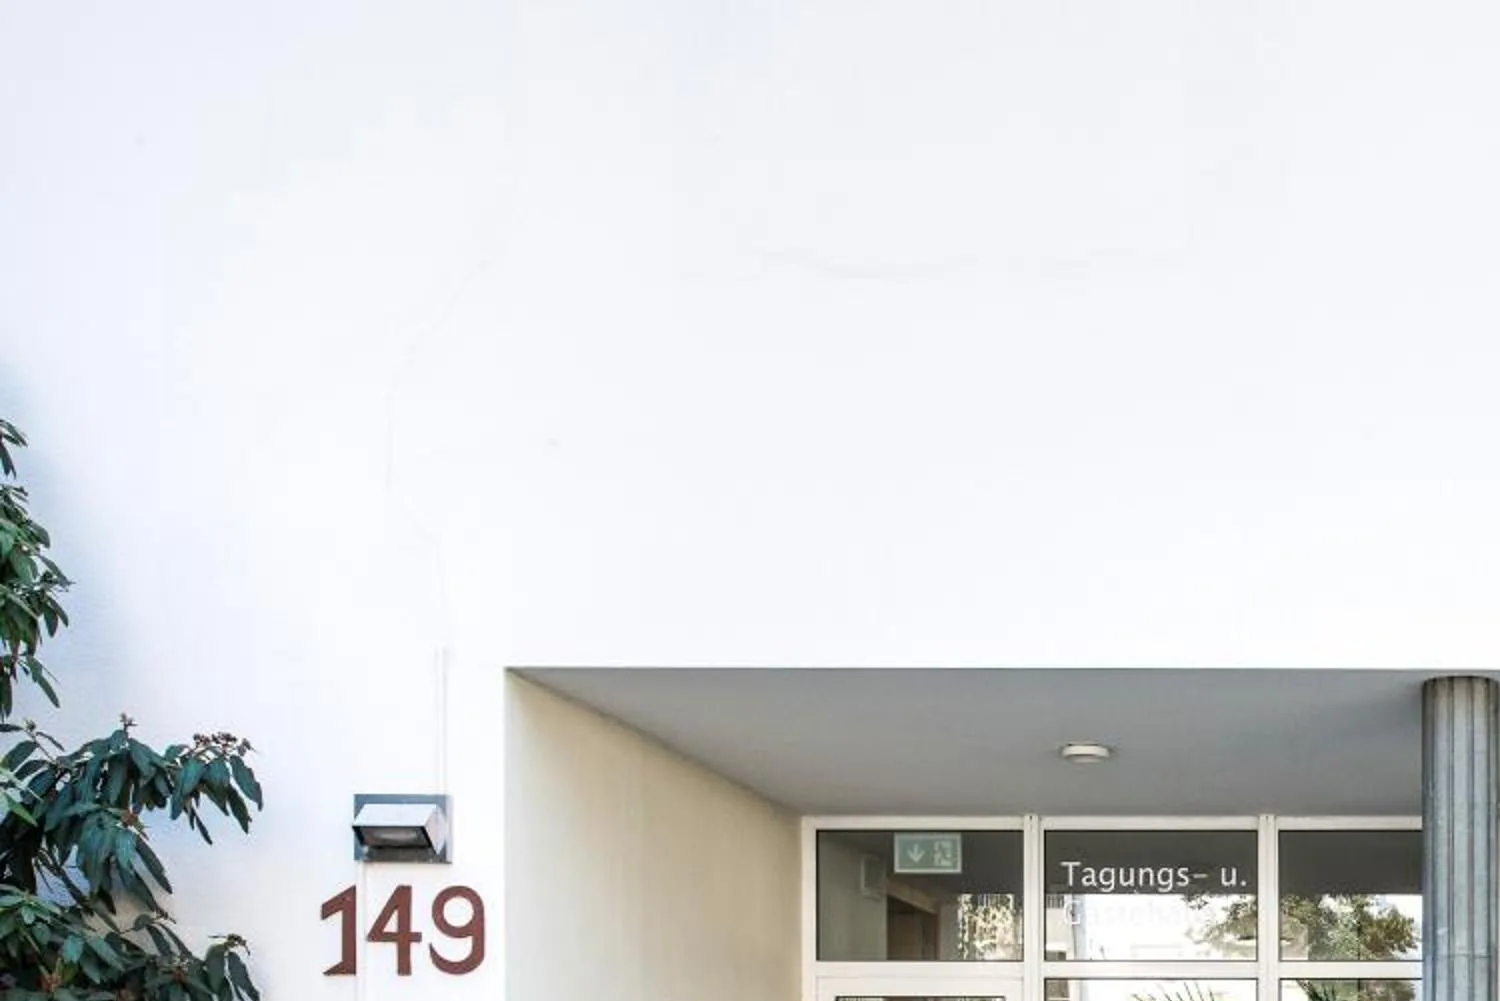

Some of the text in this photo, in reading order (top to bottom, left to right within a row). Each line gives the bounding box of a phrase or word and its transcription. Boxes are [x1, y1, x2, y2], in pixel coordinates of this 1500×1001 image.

[1060, 861, 1247, 893] Tagungs- u.
[320, 884, 486, 977] 149
